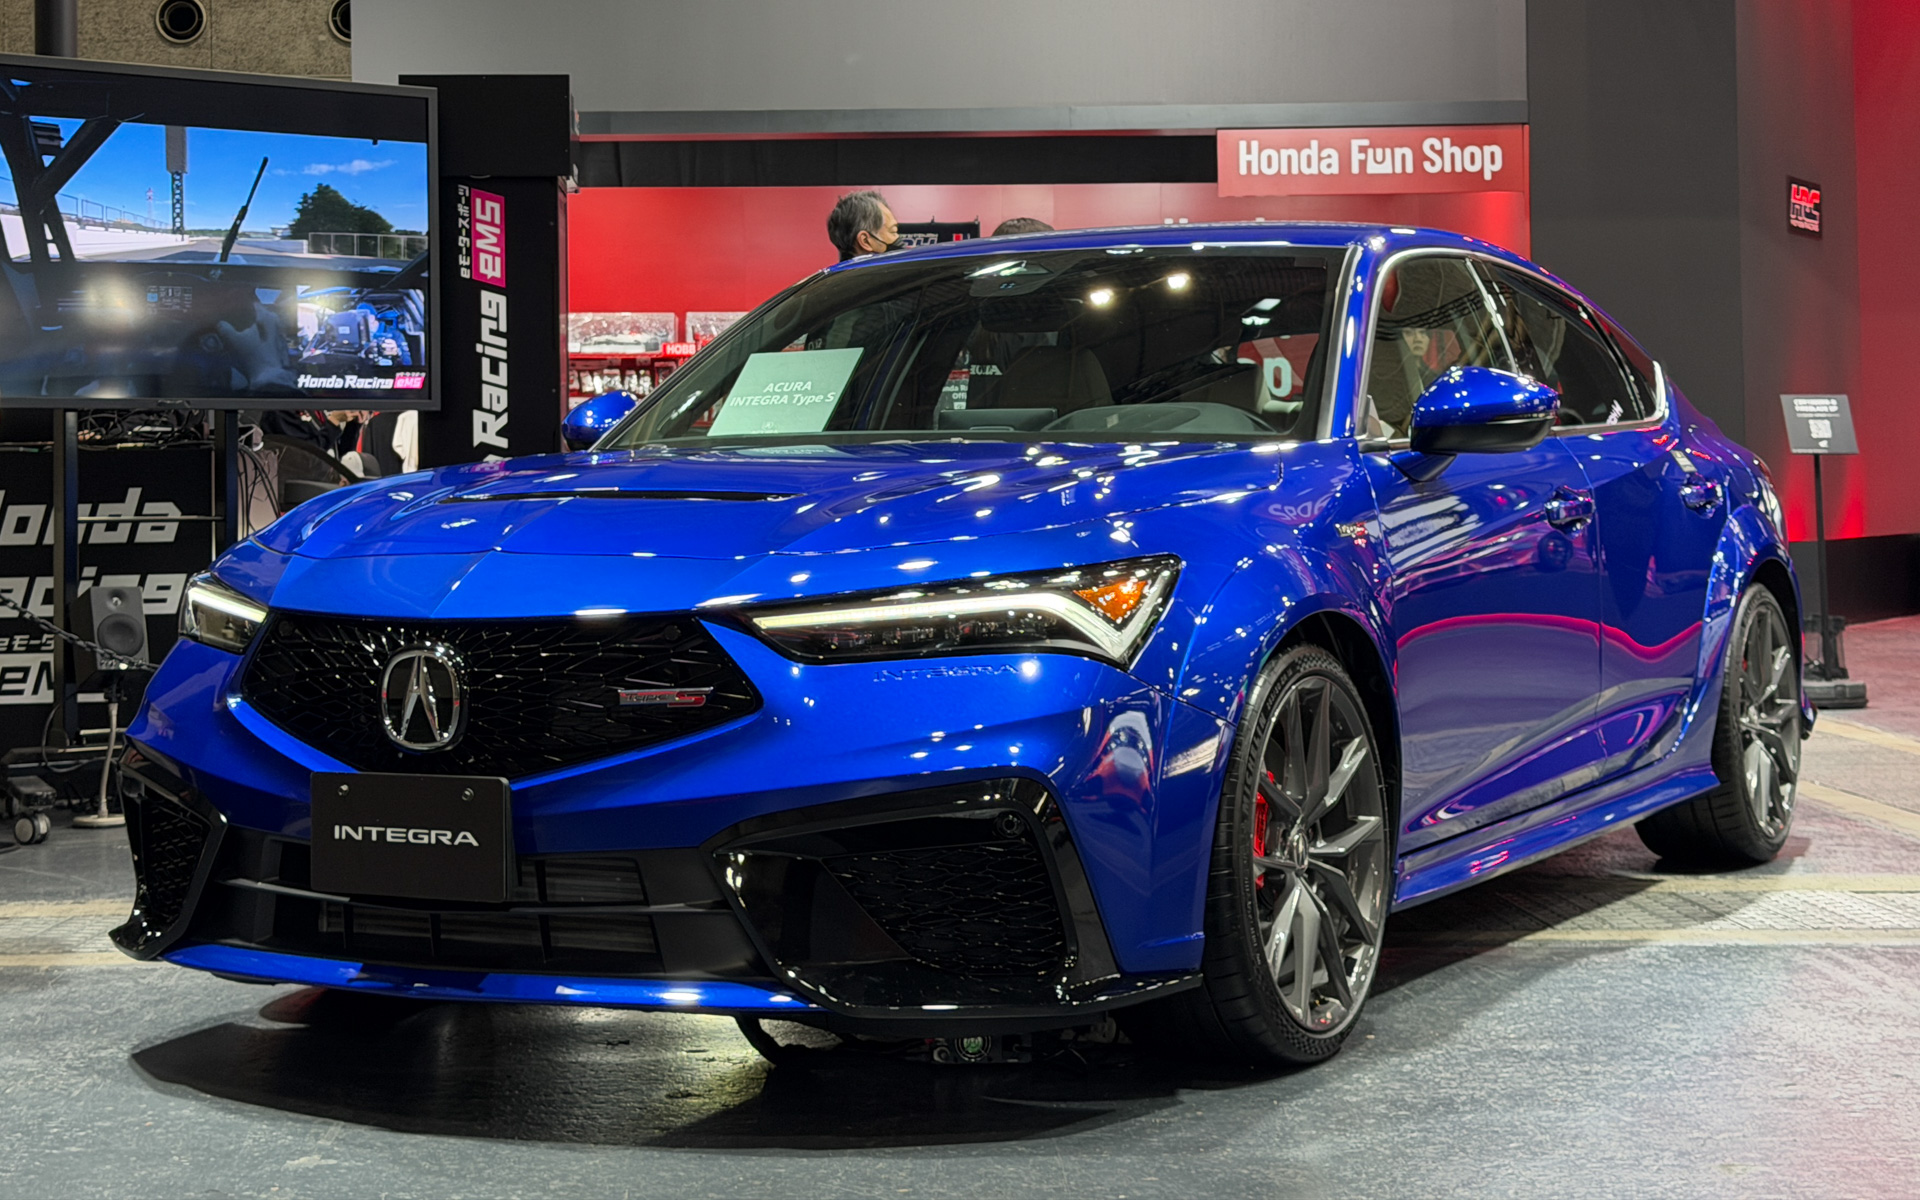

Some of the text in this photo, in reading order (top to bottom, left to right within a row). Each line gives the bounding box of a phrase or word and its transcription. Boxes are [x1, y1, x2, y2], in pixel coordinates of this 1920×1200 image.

[1238, 137, 1503, 181] Honda Fun Shop
[457, 184, 471, 280] eモータースポーツ
[475, 197, 502, 280] eMS
[666, 343, 696, 356] HOBB
[472, 289, 510, 450] Racing
[297, 374, 344, 389] Honda
[344, 375, 394, 390] Racing
[763, 381, 812, 393] ACURA
[730, 391, 837, 407] INTEGRA Type S
[333, 824, 480, 847] INTEGRA
